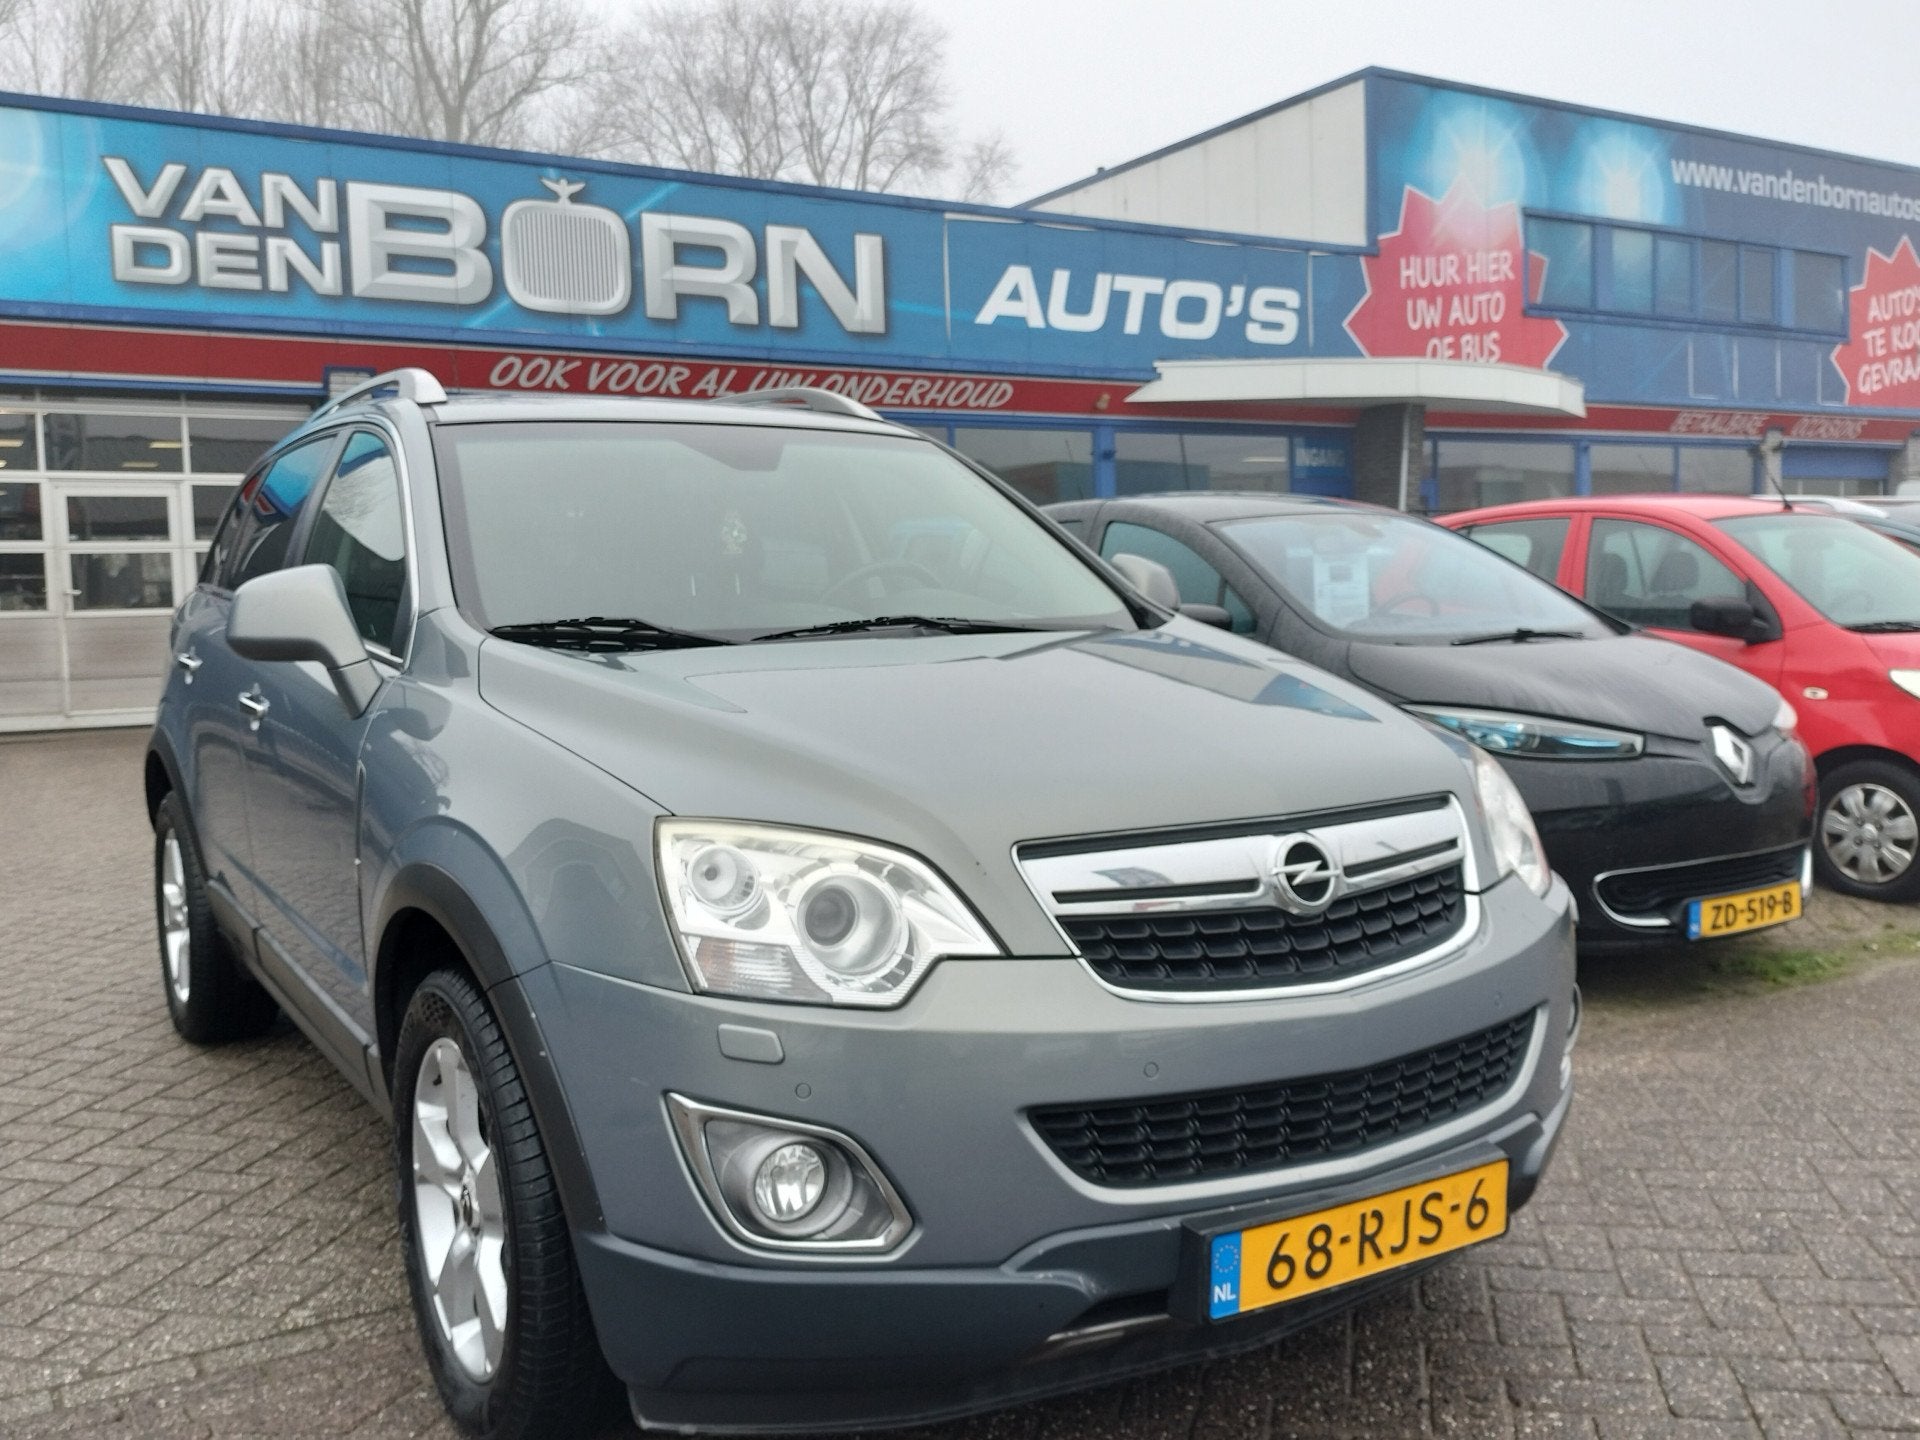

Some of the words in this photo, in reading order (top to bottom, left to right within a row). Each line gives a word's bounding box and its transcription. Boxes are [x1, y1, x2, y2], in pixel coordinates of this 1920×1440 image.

[103, 156, 339, 234] VAN
[110, 224, 343, 296] DEN
[346, 177, 886, 334] BORN
[1400, 254, 1461, 289] HUUR
[1466, 249, 1515, 285] HIER
[974, 264, 1301, 345] AUTO'S
[1406, 294, 1442, 330] UW
[1448, 290, 1505, 326] AUTO
[1461, 330, 1501, 363] BUS
[1862, 327, 1887, 358] TE
[489, 355, 582, 389] OOK
[588, 361, 691, 395] VOOR
[691, 367, 737, 396] AL
[1711, 891, 1792, 931] ZD-519-B
[1266, 1178, 1489, 1289] 68-RJS-6
[1213, 1282, 1236, 1303] NL
